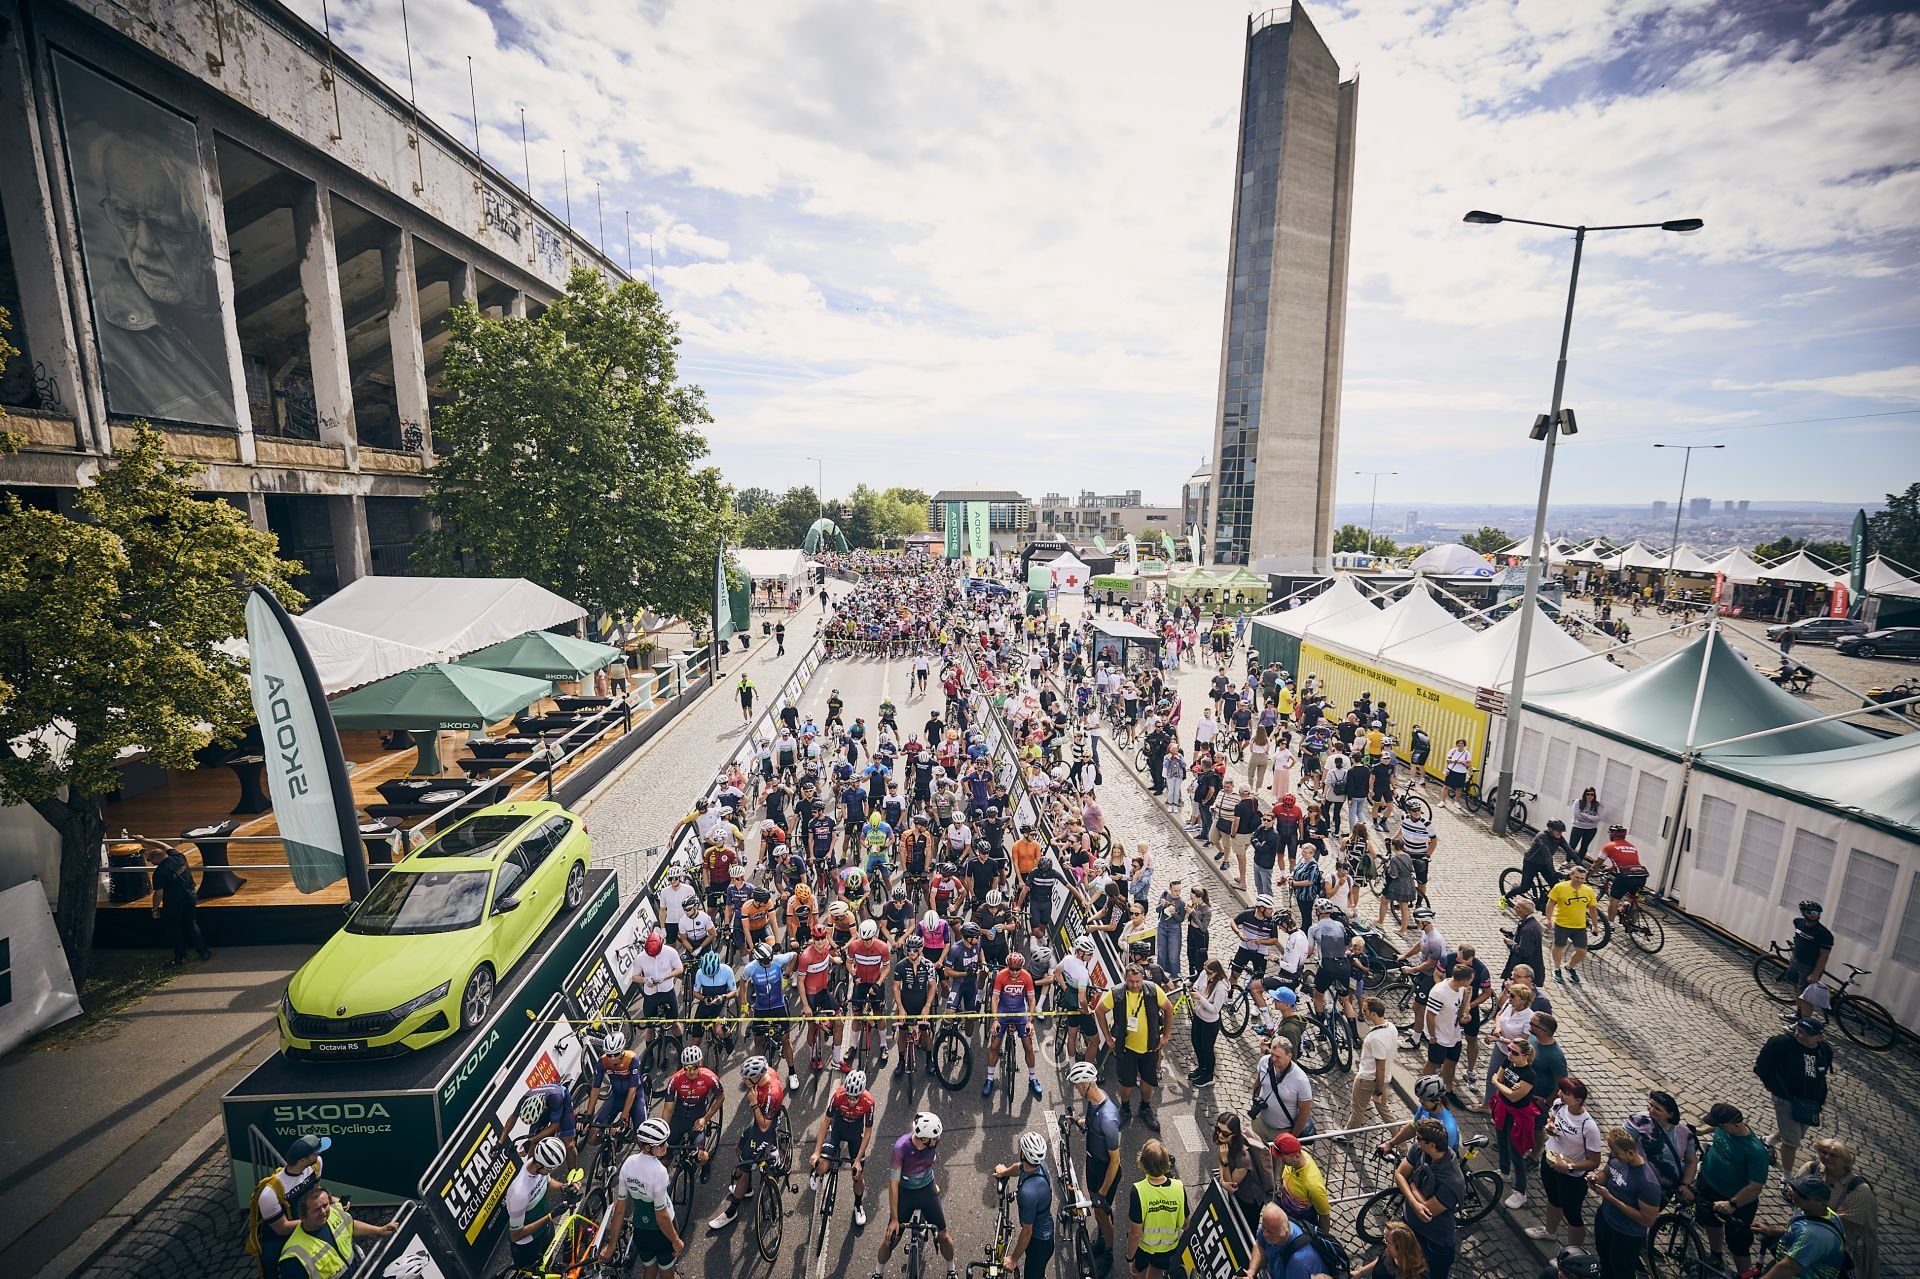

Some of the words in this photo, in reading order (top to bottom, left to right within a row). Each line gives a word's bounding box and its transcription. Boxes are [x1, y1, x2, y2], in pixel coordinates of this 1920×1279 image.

[1366, 669, 1376, 679] TOUR
[275, 1126, 297, 1136] We
[331, 1123, 392, 1135] Cycling.cz
[458, 1193, 481, 1231] CZECH
[478, 1148, 509, 1199] REPUBLIC
[484, 1196, 496, 1213] TOUR
[494, 1188, 501, 1198] DE
[499, 1165, 515, 1192] FRANCE
